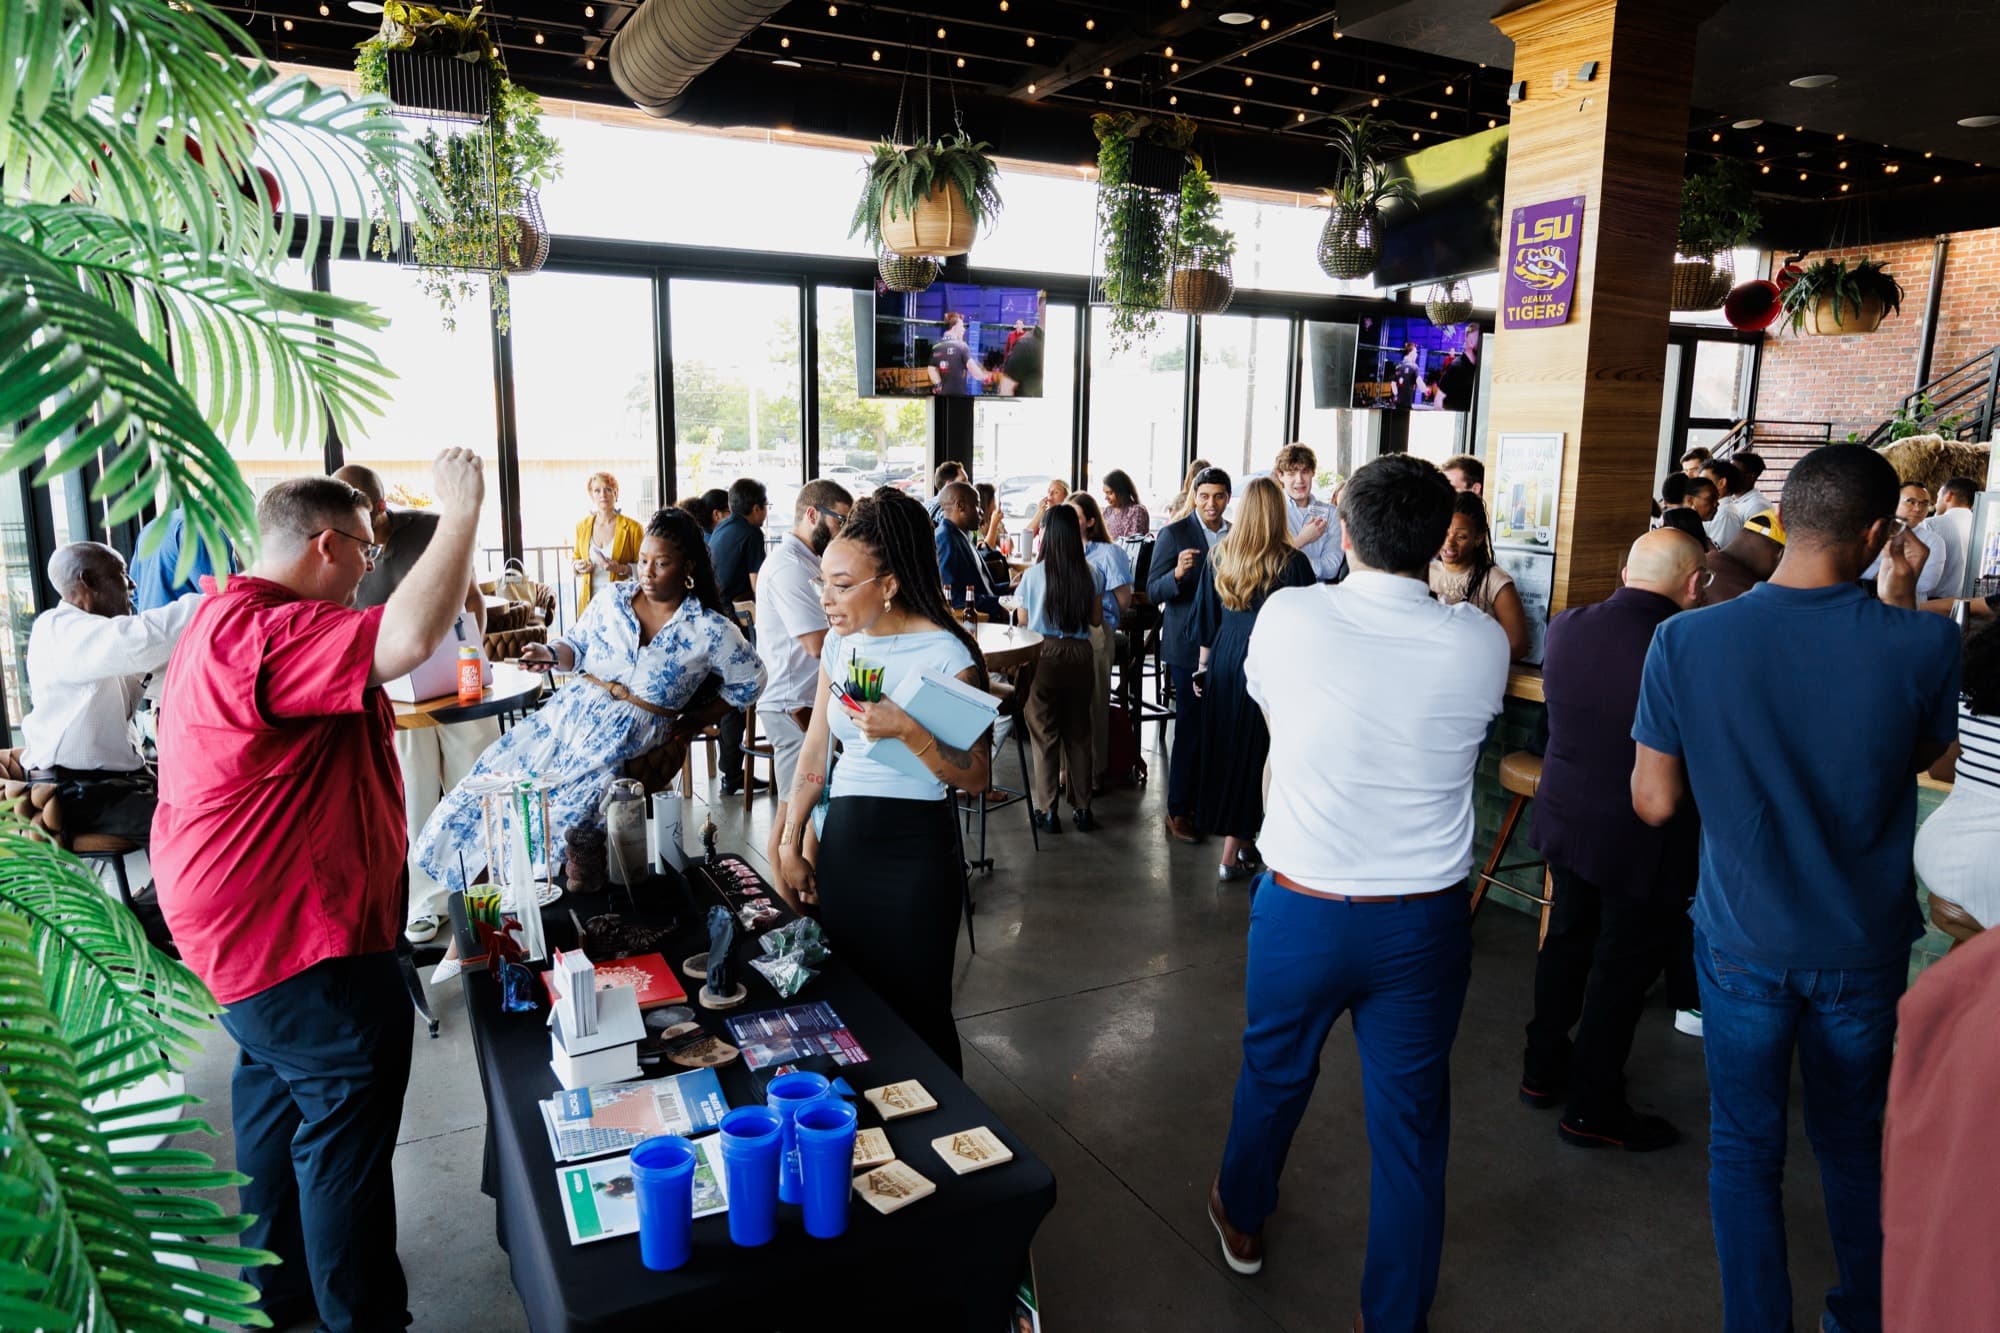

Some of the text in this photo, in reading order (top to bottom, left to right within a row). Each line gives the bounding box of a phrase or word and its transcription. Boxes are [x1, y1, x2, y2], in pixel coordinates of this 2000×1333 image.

[1516, 214, 1573, 246] LSU
[1521, 294, 1553, 303] GEAUX
[1507, 302, 1566, 321] TIGERS
